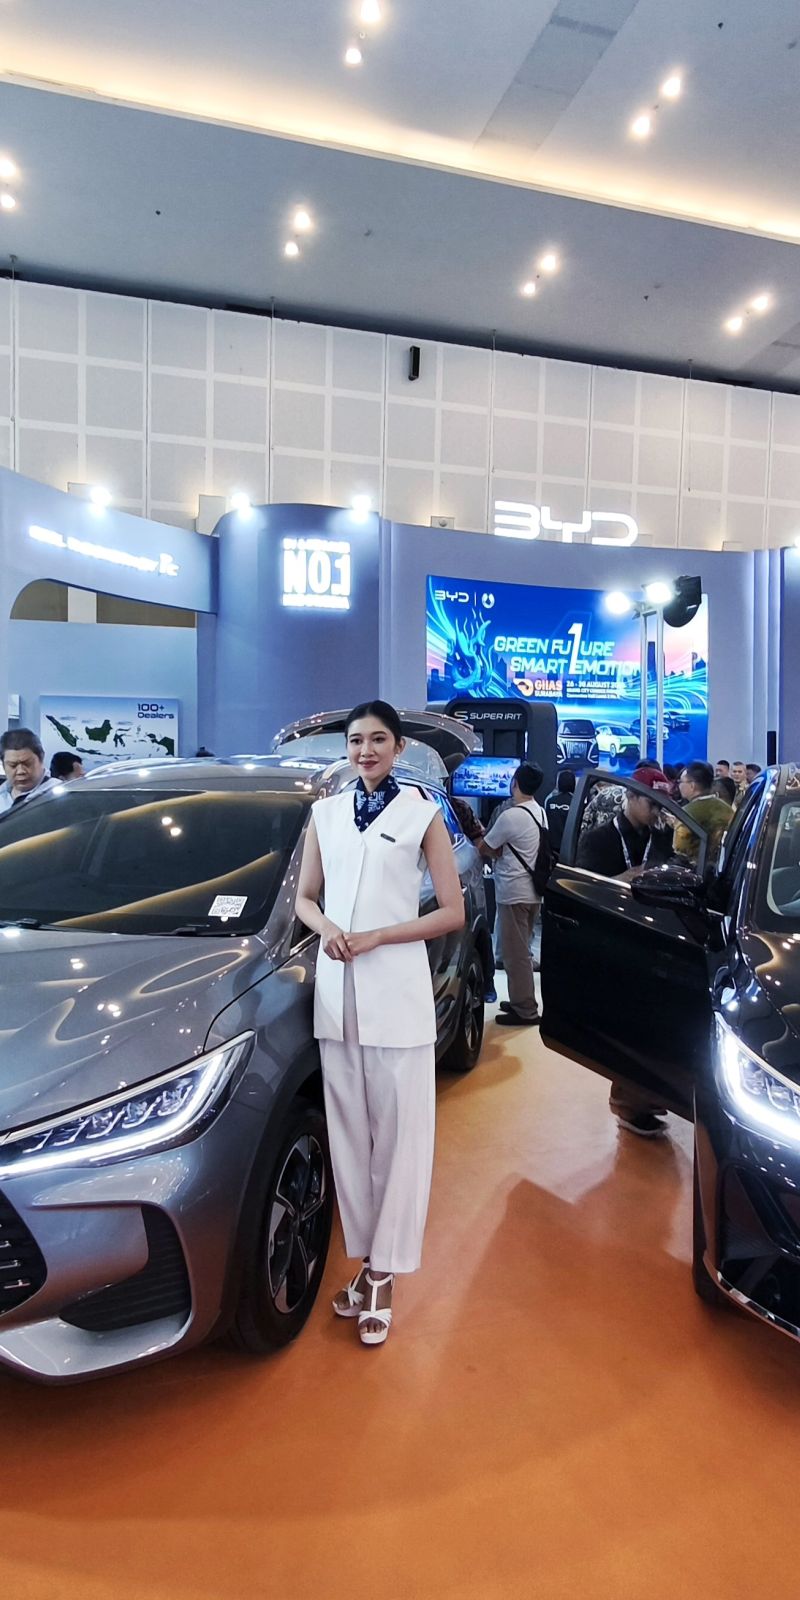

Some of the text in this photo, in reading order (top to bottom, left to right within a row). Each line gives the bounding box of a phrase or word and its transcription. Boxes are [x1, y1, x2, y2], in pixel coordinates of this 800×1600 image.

[494, 500, 638, 547] BYD
[434, 589, 469, 602] BYD
[494, 635, 549, 654] GREEN
[510, 656, 568, 674] SMART
[137, 703, 165, 711] 100+
[470, 712, 503, 720] SUPER
